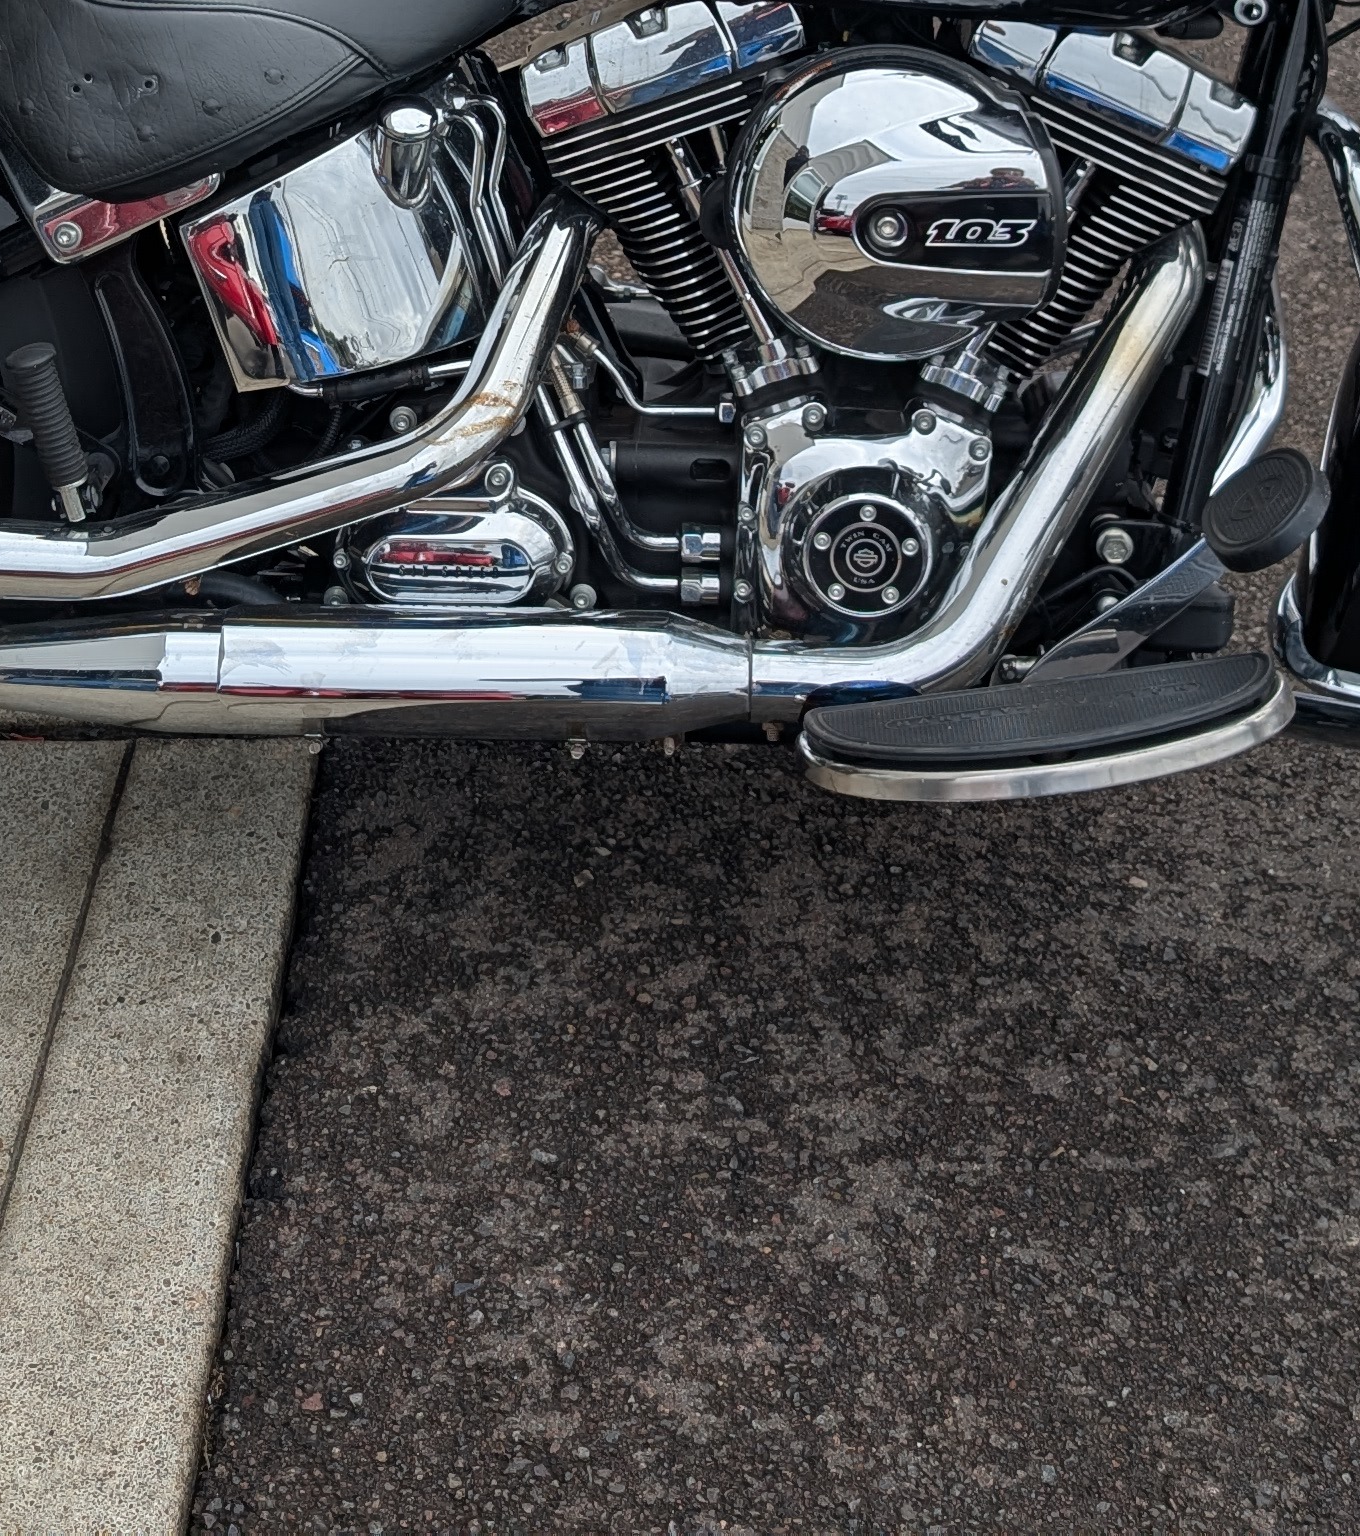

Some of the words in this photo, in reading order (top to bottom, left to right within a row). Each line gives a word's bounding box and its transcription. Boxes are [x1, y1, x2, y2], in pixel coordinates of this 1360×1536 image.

[925, 218, 1037, 247] 103
[840, 530, 865, 549] TWIN
[872, 532, 893, 552] CAM
[398, 565, 429, 576] SIX
[440, 565, 499, 578] SPEED
[853, 576, 876, 585] USA
